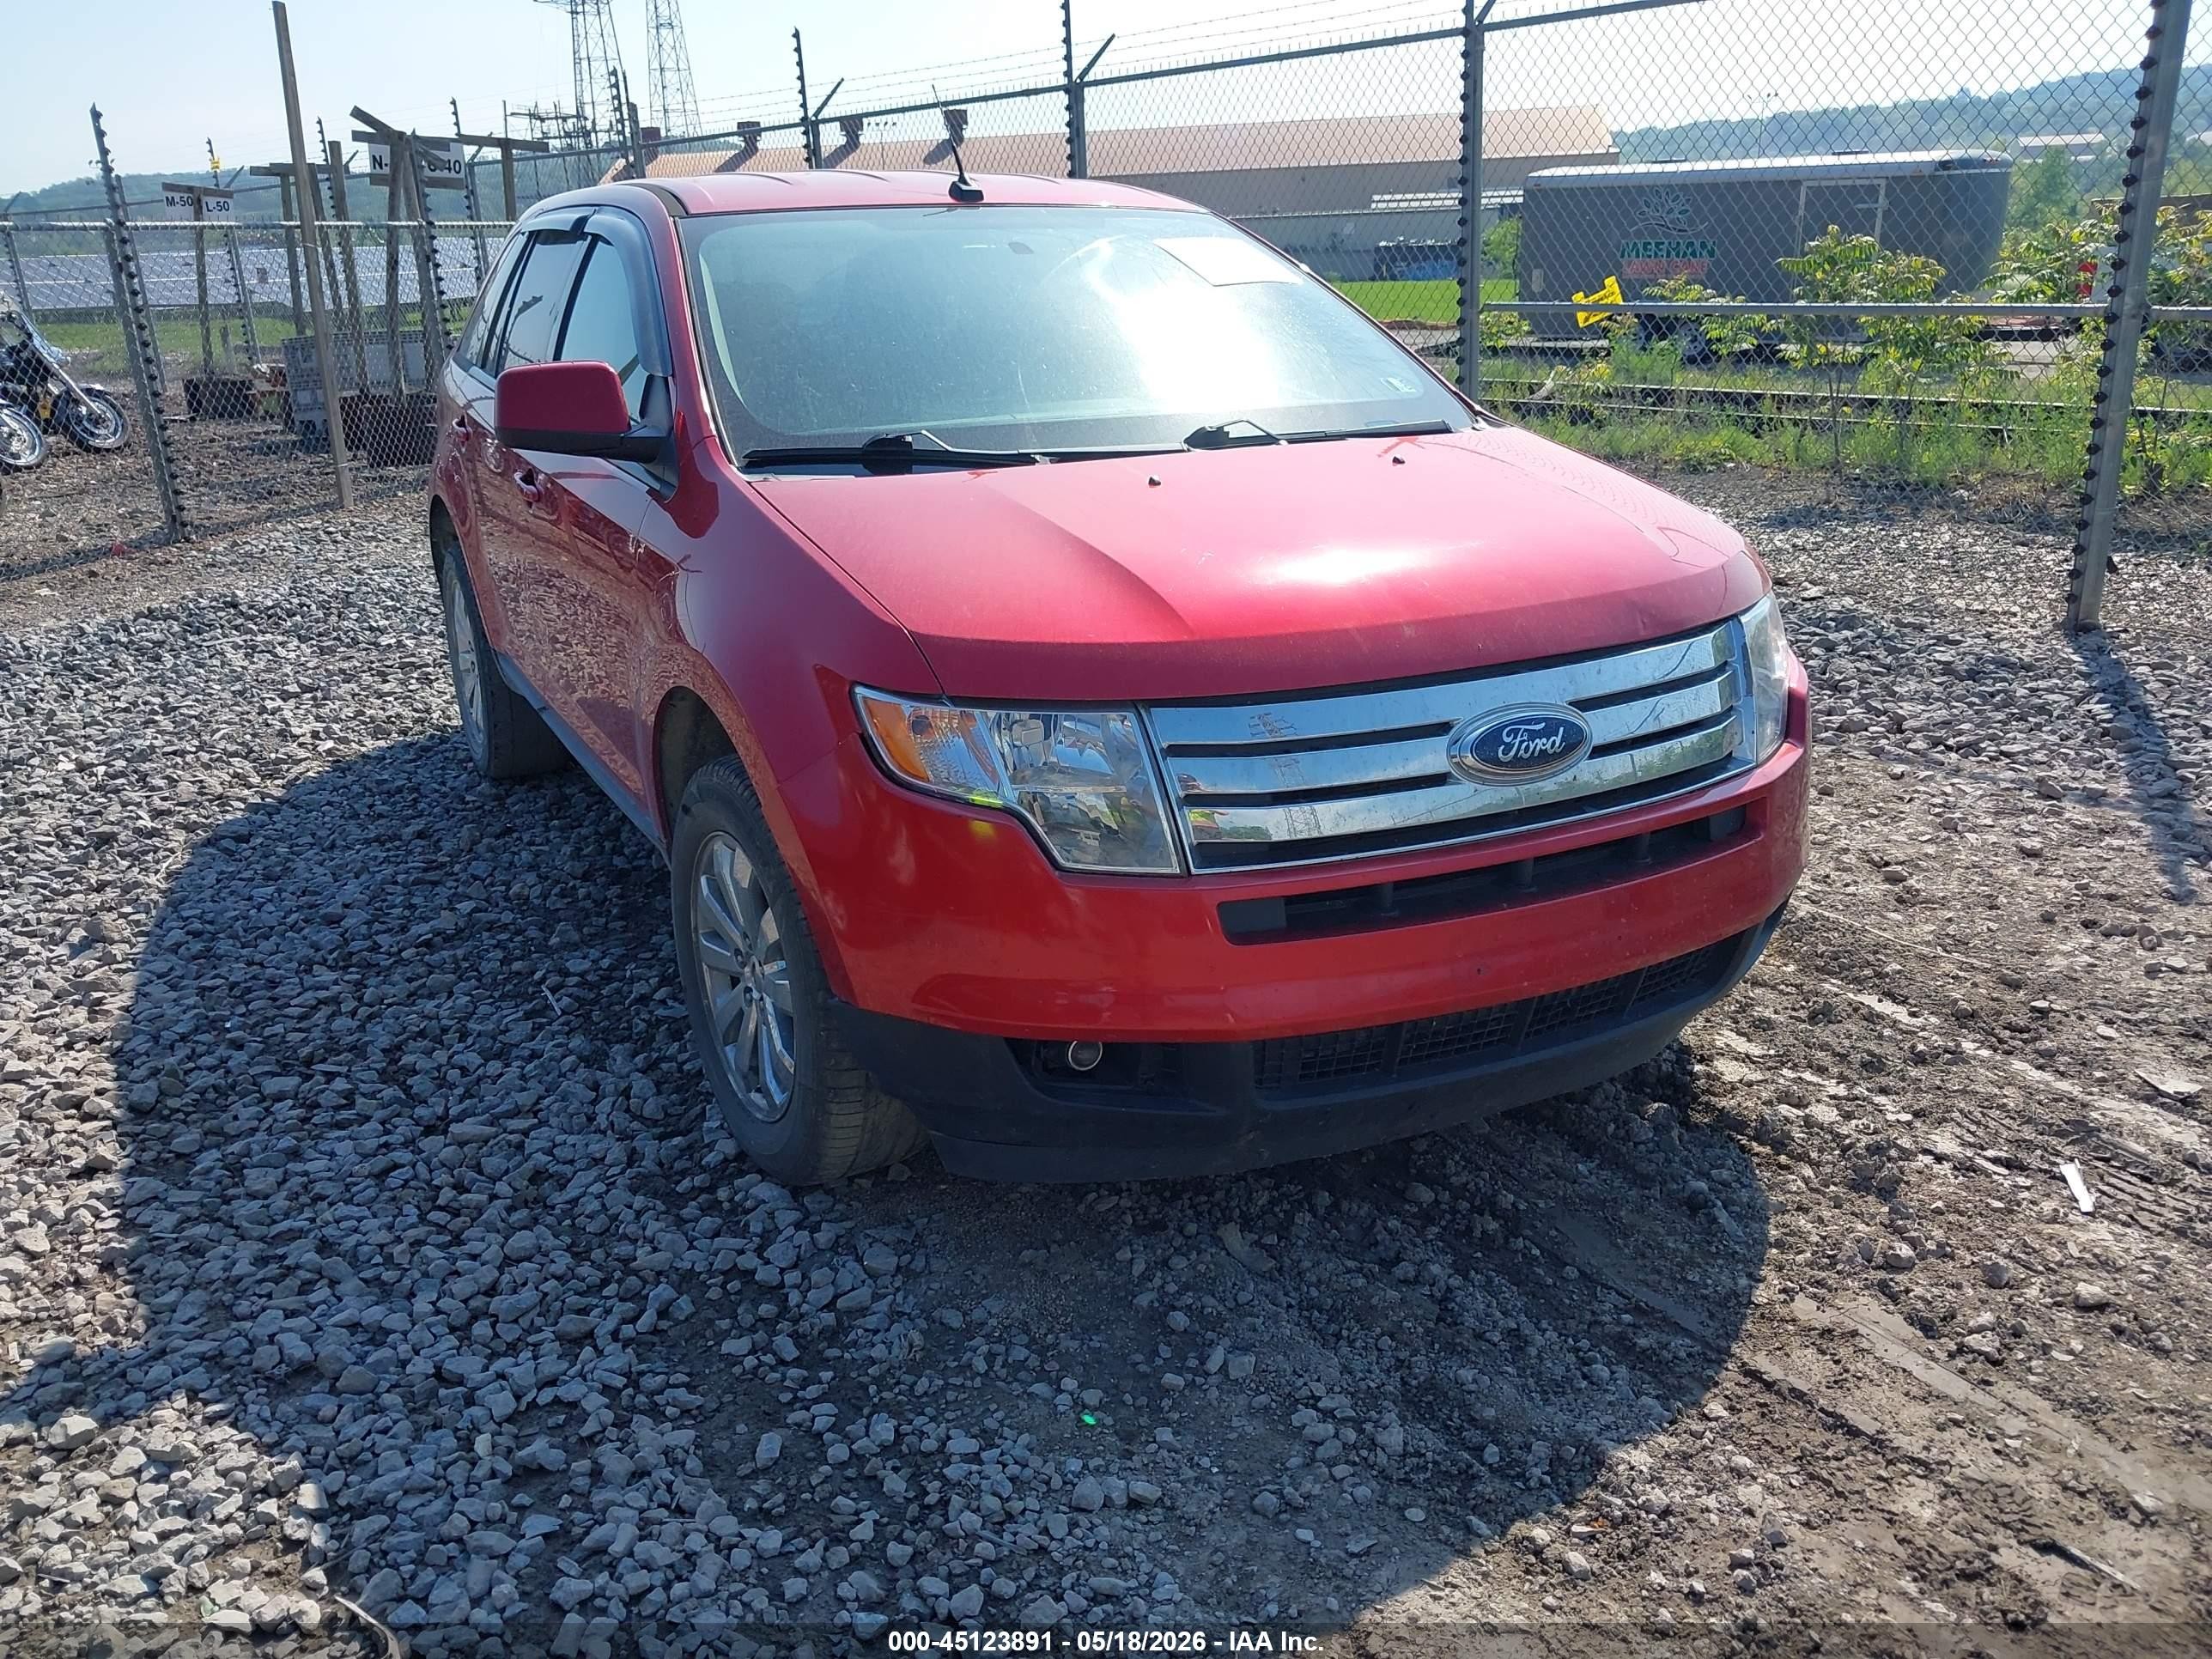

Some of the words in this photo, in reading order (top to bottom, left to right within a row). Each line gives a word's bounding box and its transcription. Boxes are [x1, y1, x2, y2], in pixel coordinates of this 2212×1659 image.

[165, 196, 193, 207] M-50
[205, 200, 230, 213] L-50
[1620, 240, 1717, 259] MEEHAN
[1498, 721, 1565, 763] Ford
